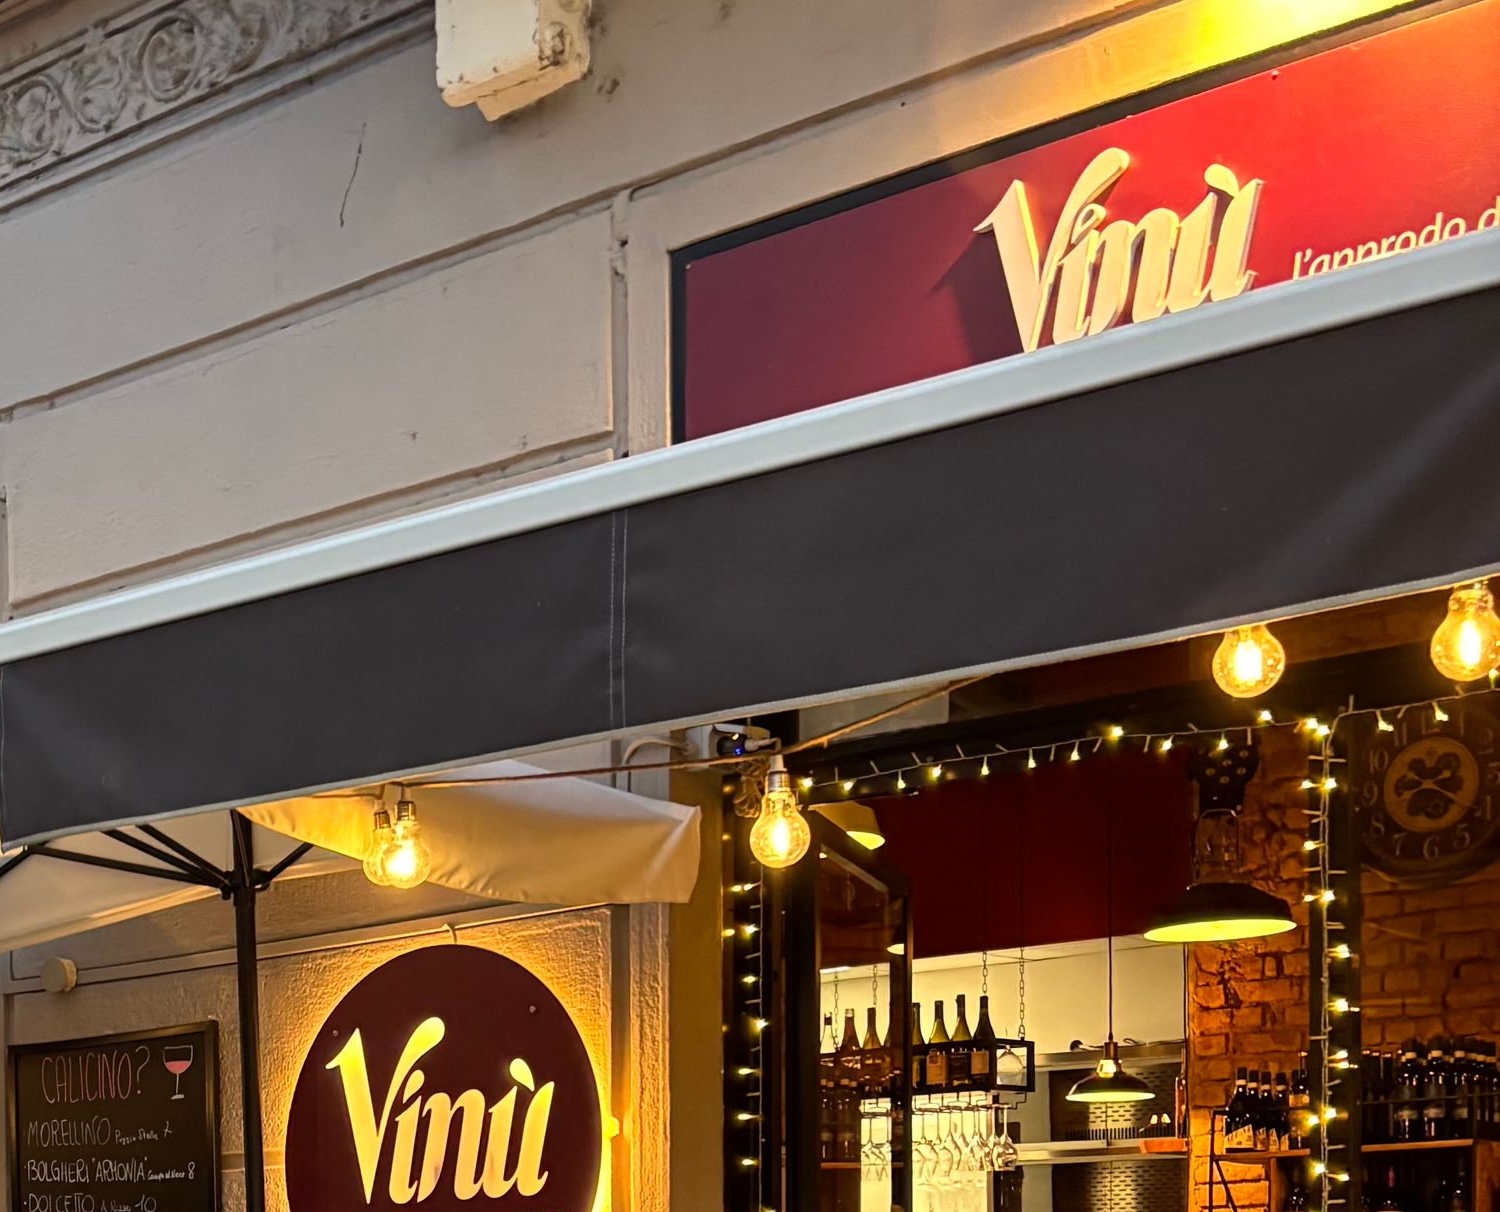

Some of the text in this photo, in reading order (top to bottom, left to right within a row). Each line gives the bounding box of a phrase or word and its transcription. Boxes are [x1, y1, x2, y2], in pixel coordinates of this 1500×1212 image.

[972, 146, 1266, 353] Vinù
[41, 1045, 150, 1104] CALICINO?
[27, 1115, 111, 1147] MORELLINO
[324, 1016, 556, 1205] Vinù
[27, 1158, 90, 1184] BOLGHERI
[187, 1161, 196, 1180] 8
[134, 1194, 157, 1212] 10
